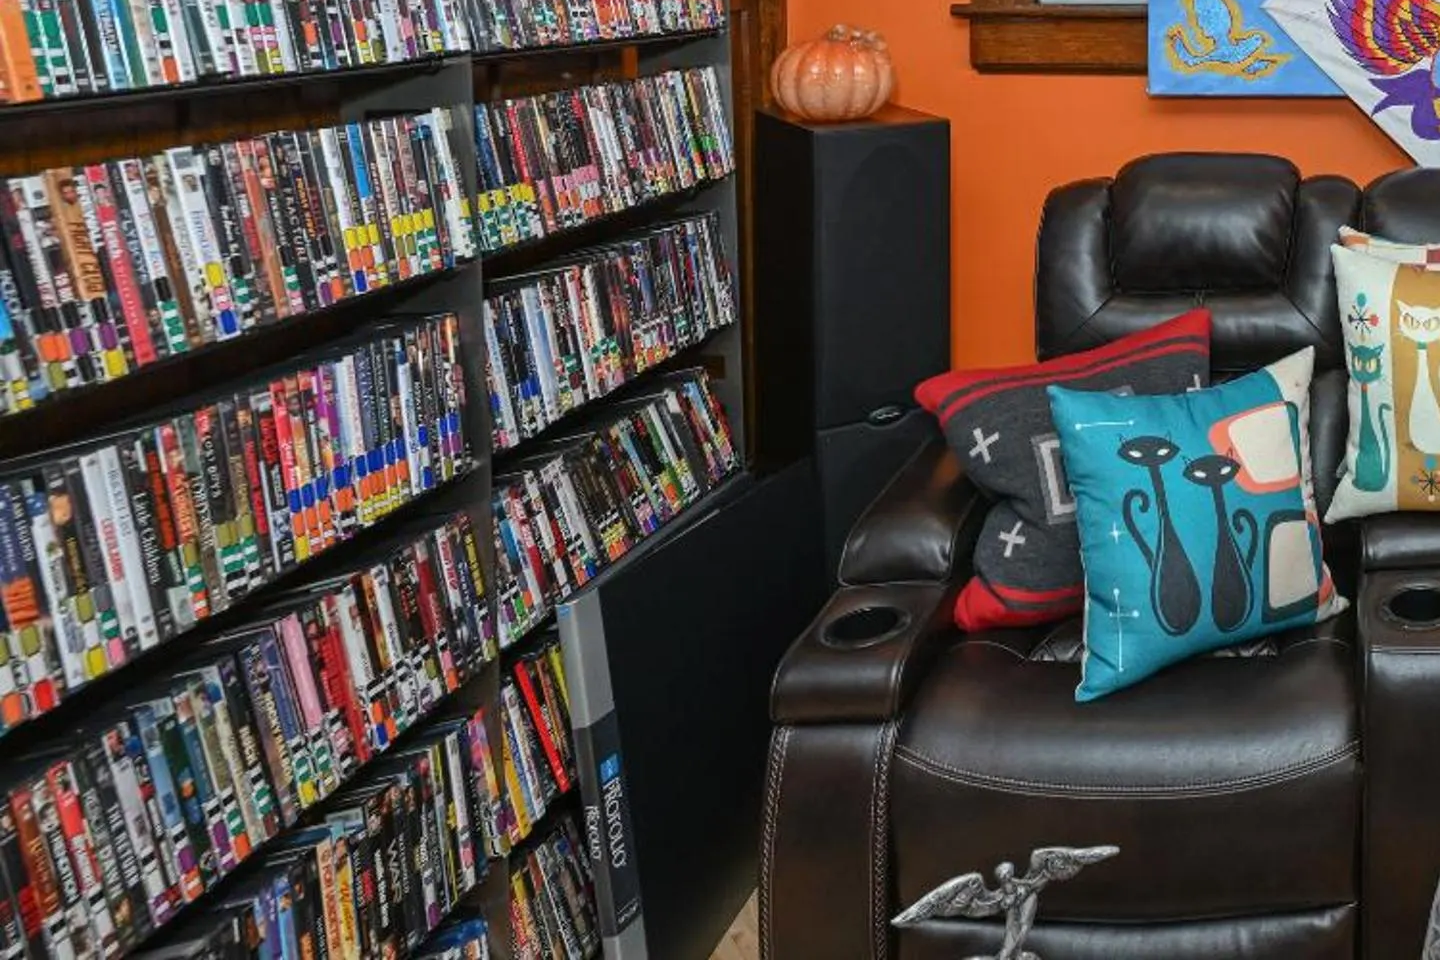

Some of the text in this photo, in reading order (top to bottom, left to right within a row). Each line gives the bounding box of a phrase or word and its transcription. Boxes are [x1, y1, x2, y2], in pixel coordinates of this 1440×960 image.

[282, 186, 308, 263] FRACTURE
[132, 492, 152, 526] Little
[139, 527, 165, 584] Children
[262, 690, 281, 735] ROCKY
